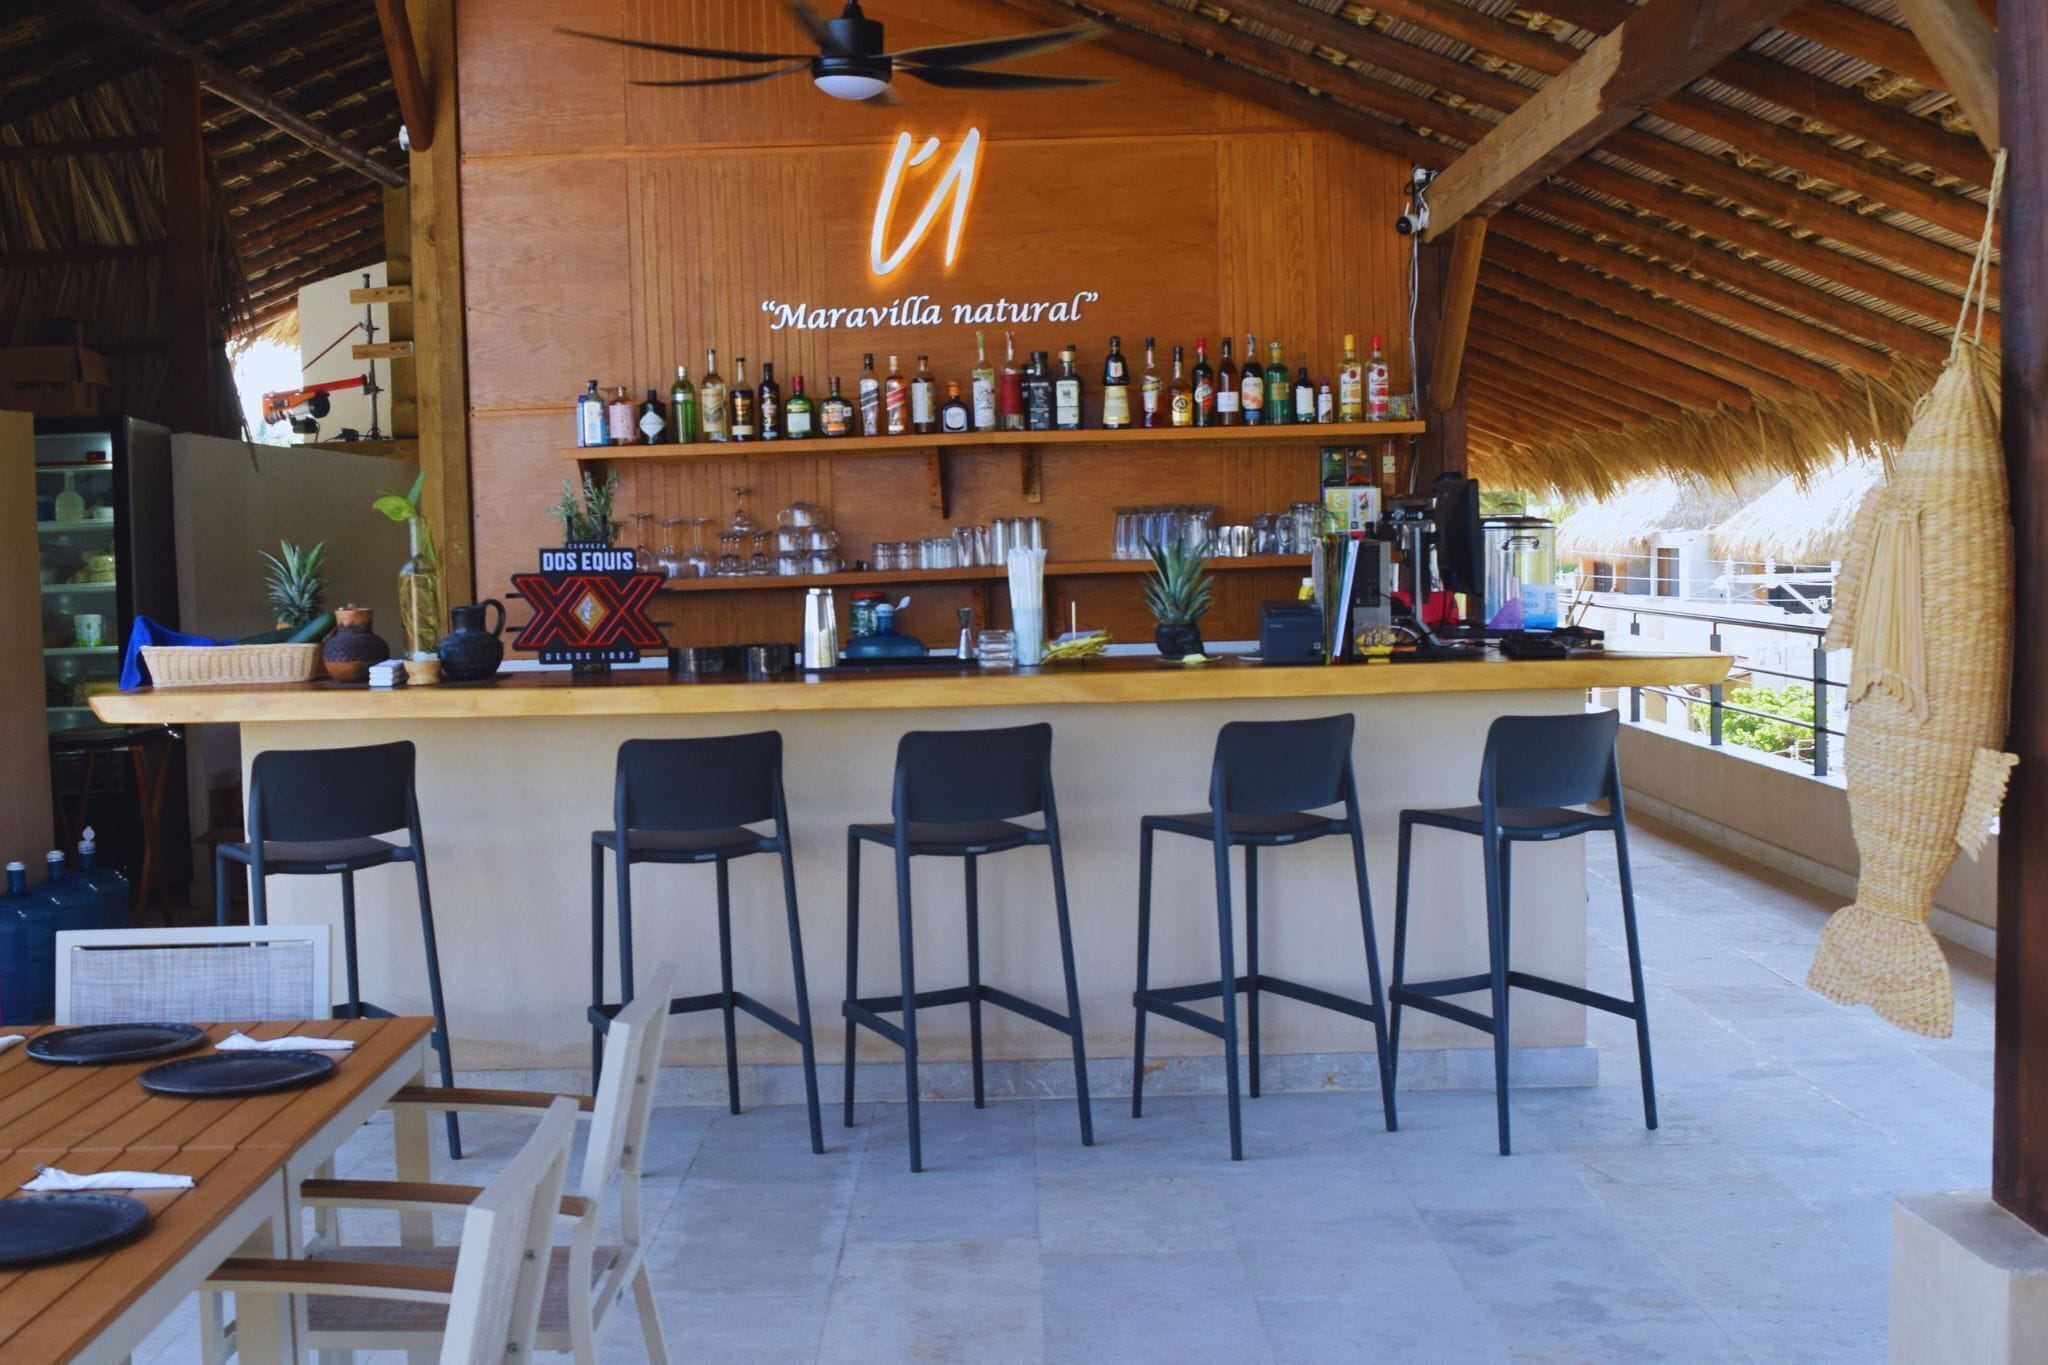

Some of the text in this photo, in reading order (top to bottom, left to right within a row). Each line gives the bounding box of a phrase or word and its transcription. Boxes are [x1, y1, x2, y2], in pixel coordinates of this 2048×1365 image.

[542, 551, 634, 572] DOS EQUIS
[515, 575, 662, 648] XX
[545, 652, 592, 661] DESDE
